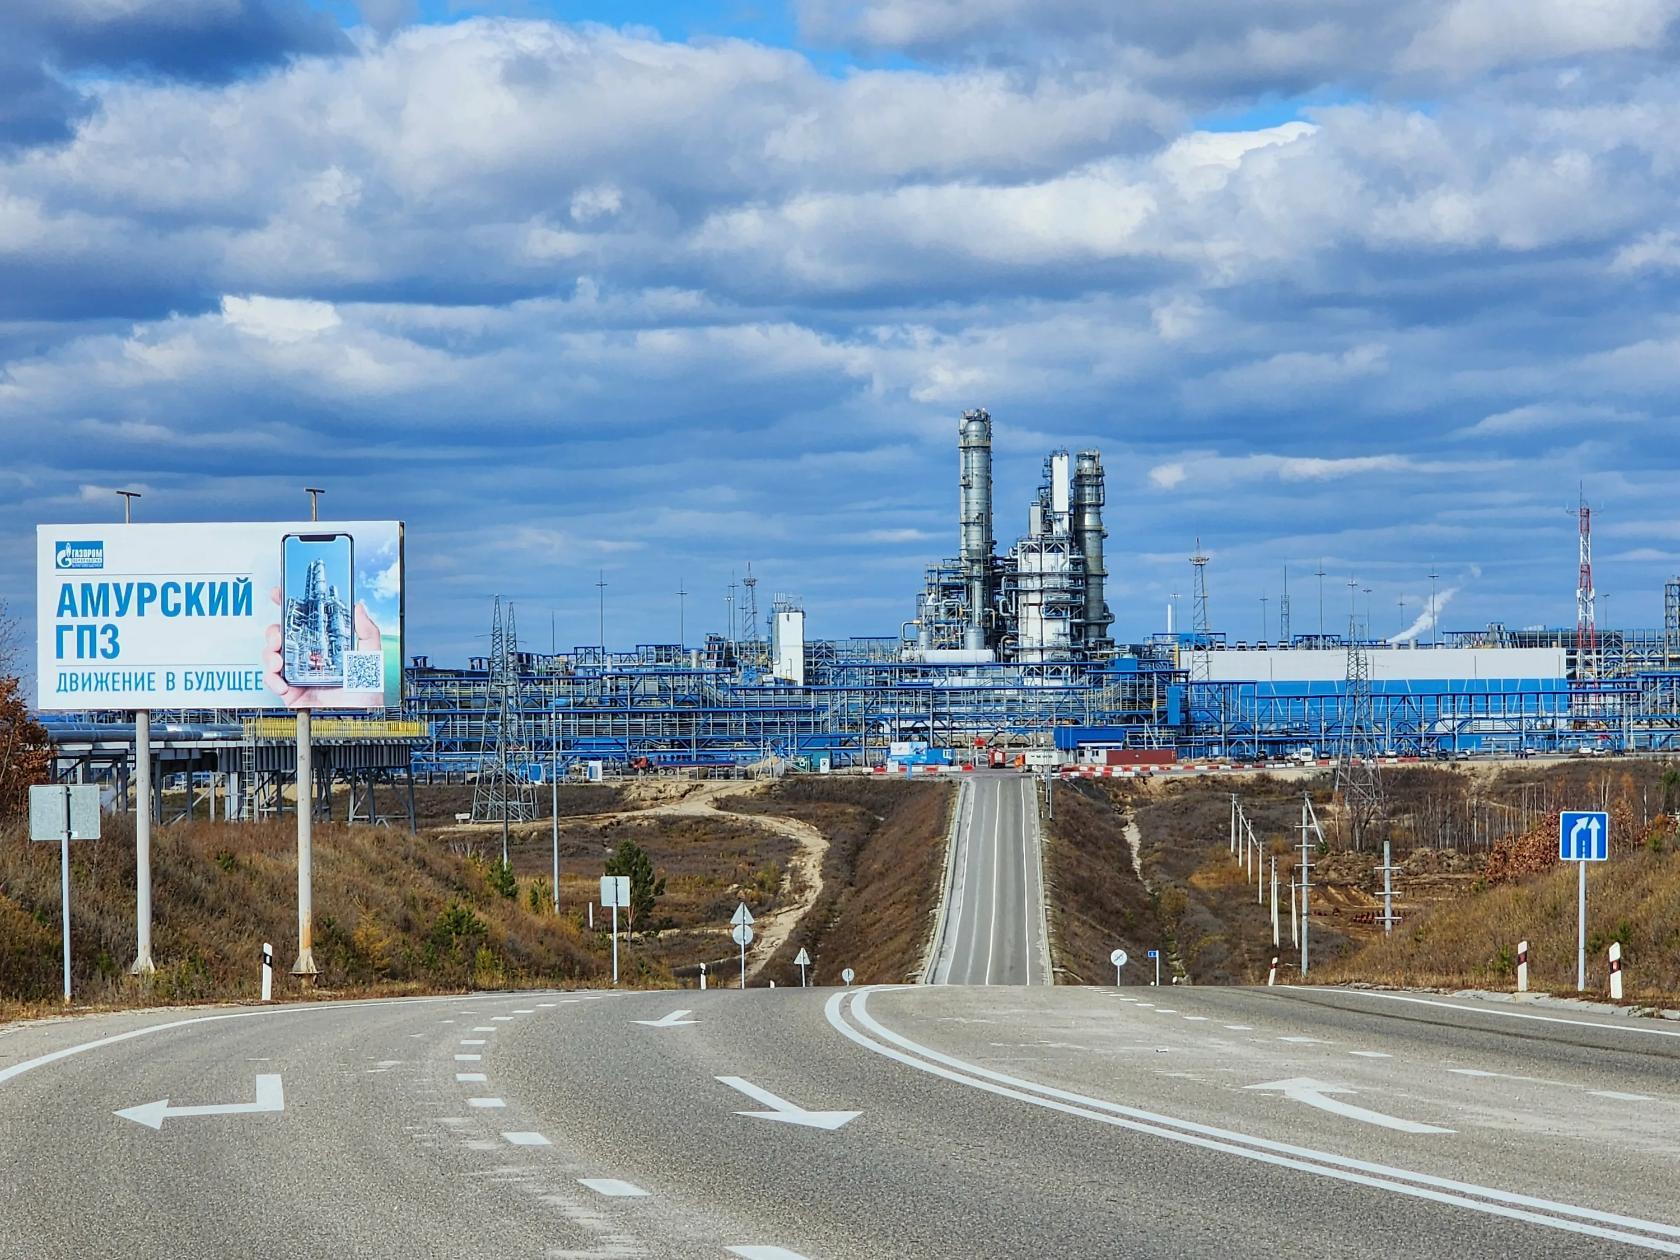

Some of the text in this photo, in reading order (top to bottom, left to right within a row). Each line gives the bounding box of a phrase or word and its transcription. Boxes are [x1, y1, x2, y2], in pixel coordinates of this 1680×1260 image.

[56, 576, 253, 618] АМУРСКИЙ
[56, 624, 120, 660] ГПЗ
[56, 670, 263, 693] ДВИЖЕНИЕ В БУДУЩЕЕ
